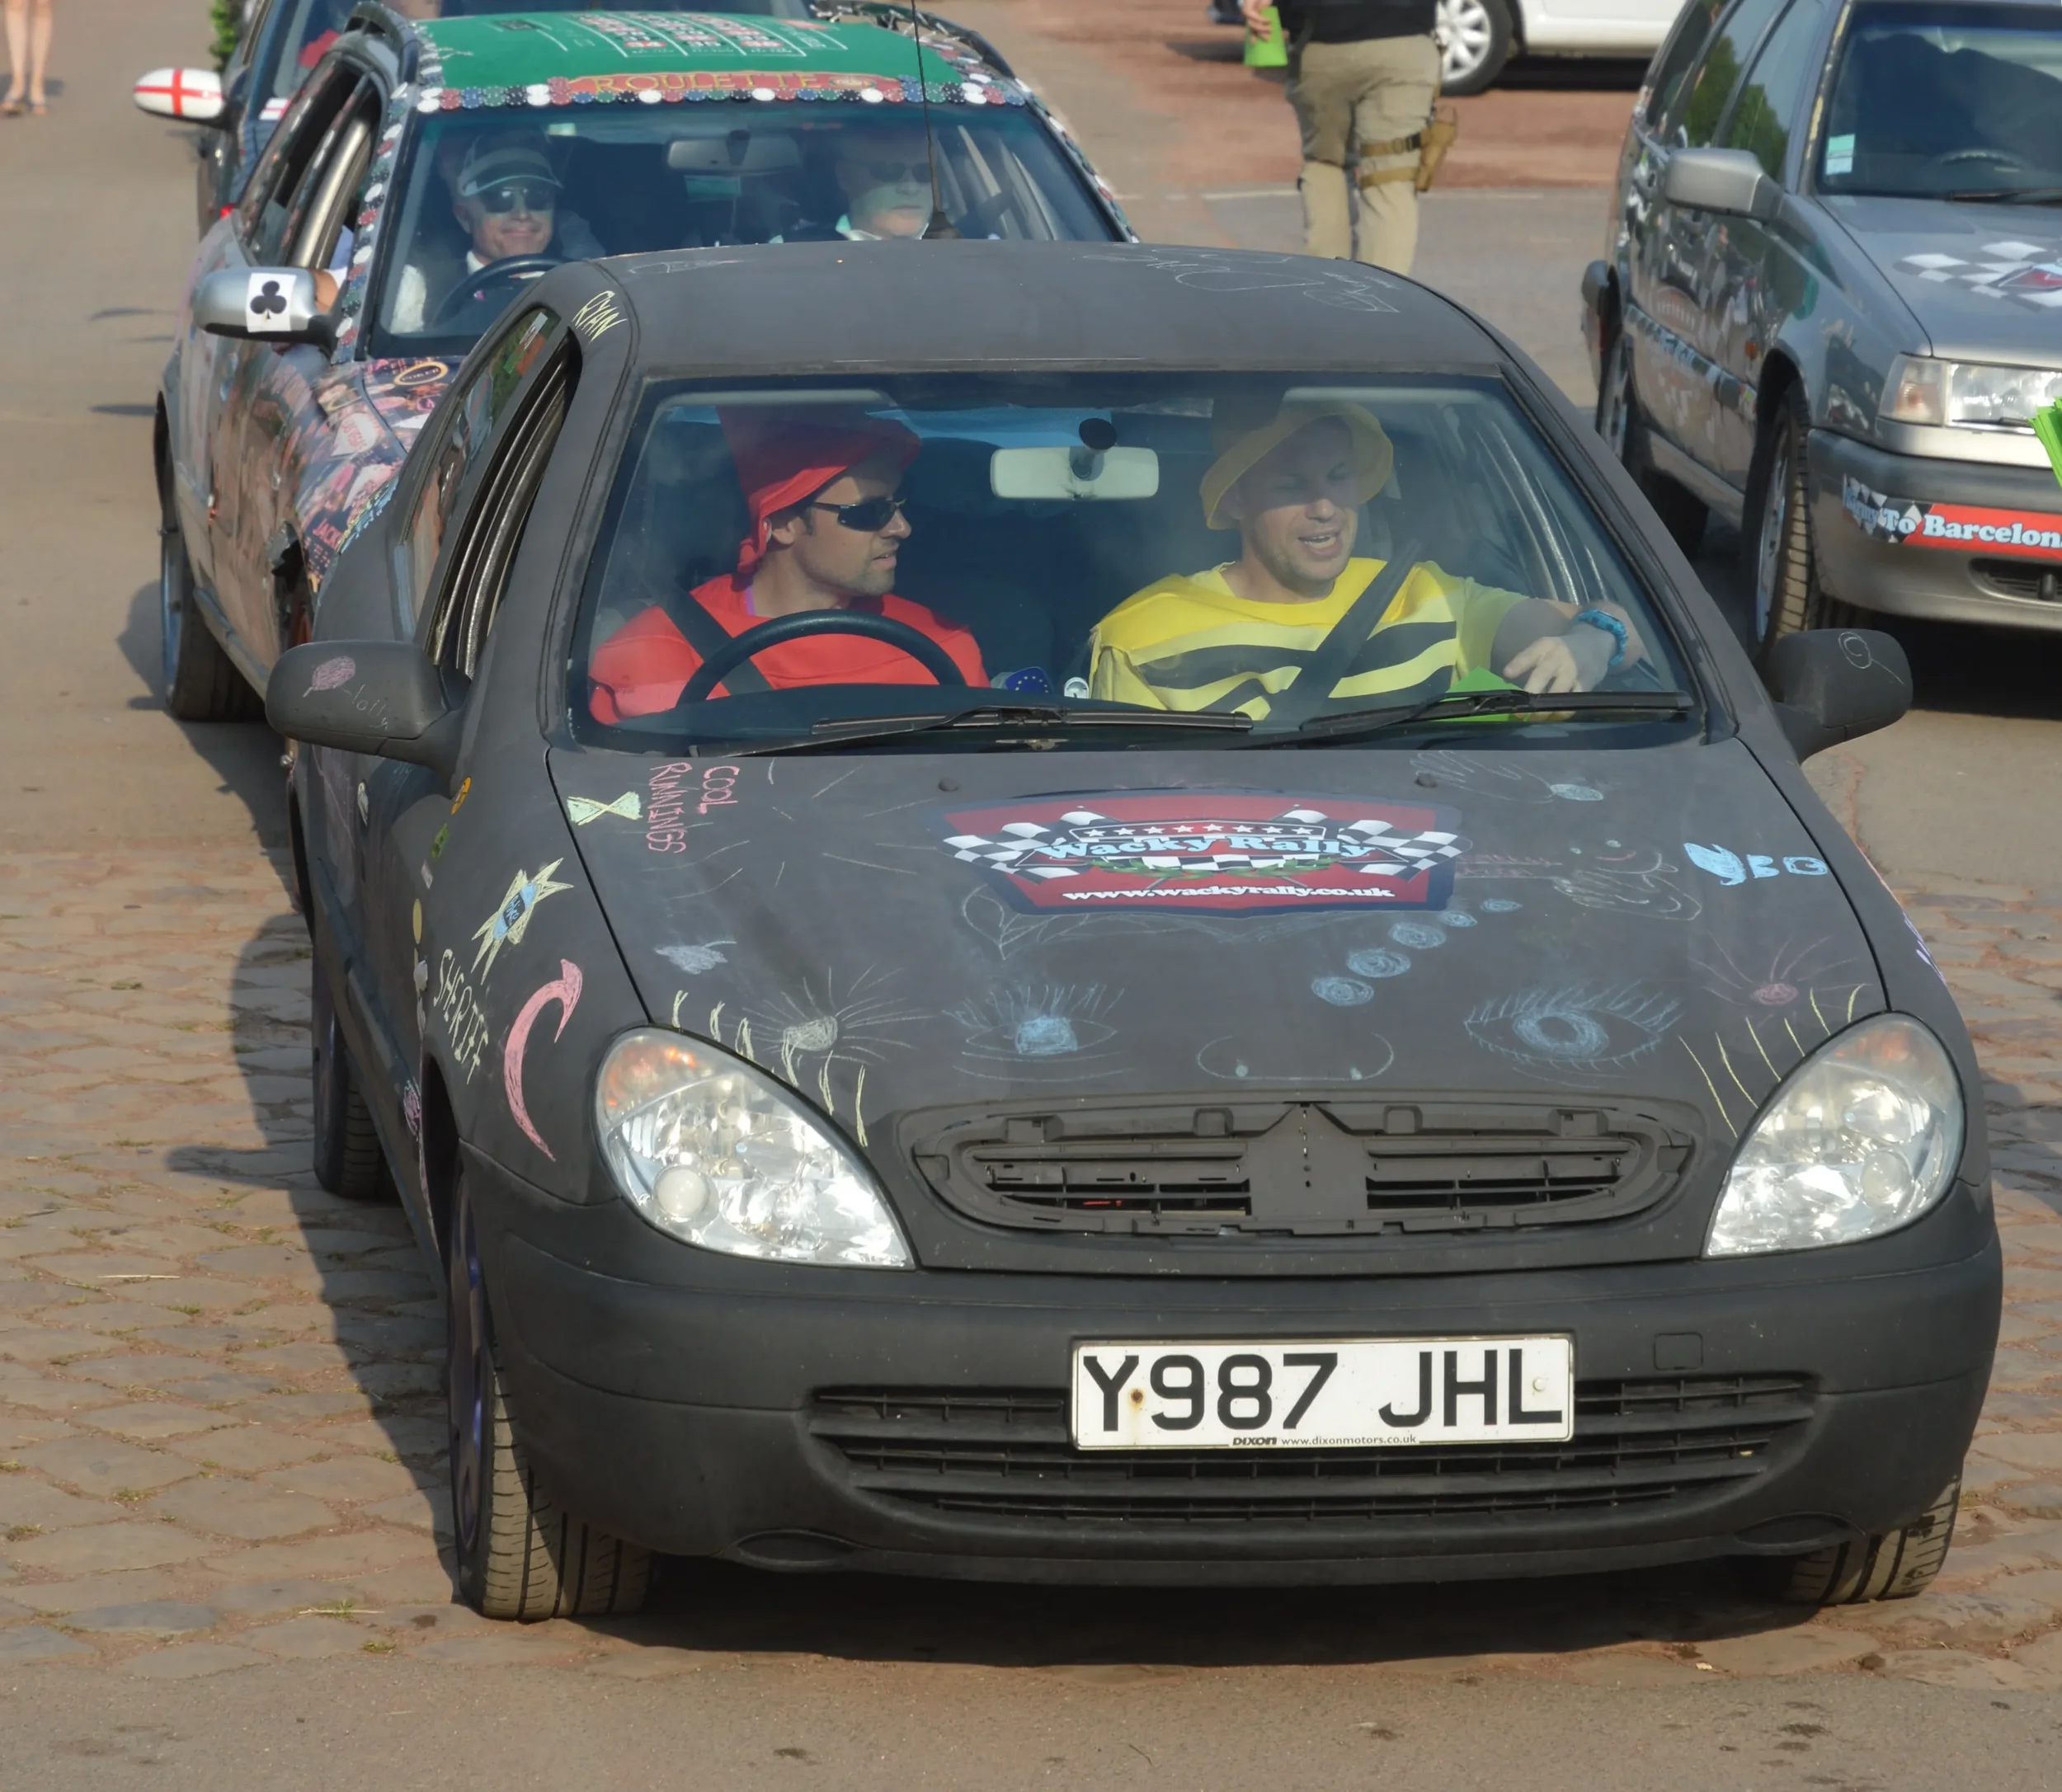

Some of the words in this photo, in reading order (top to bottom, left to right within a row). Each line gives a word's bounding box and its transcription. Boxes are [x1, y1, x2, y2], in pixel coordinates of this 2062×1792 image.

[596, 74, 822, 94] ROULETTE
[1881, 507, 1918, 534] To
[1923, 514, 2062, 548] Barcelon
[646, 762, 693, 854] RUNNINGS
[697, 765, 741, 816] COOL
[1034, 836, 1217, 859] Wacky
[1226, 835, 1377, 858] Rally
[1062, 885, 1396, 901] www.wackyrally.co.uk
[433, 948, 489, 1085] SHERIFF
[1082, 1352, 1339, 1432] Y987
[1377, 1348, 1564, 1428] JHL
[1281, 1433, 1417, 1446] www.dixonmotors.co.uk
